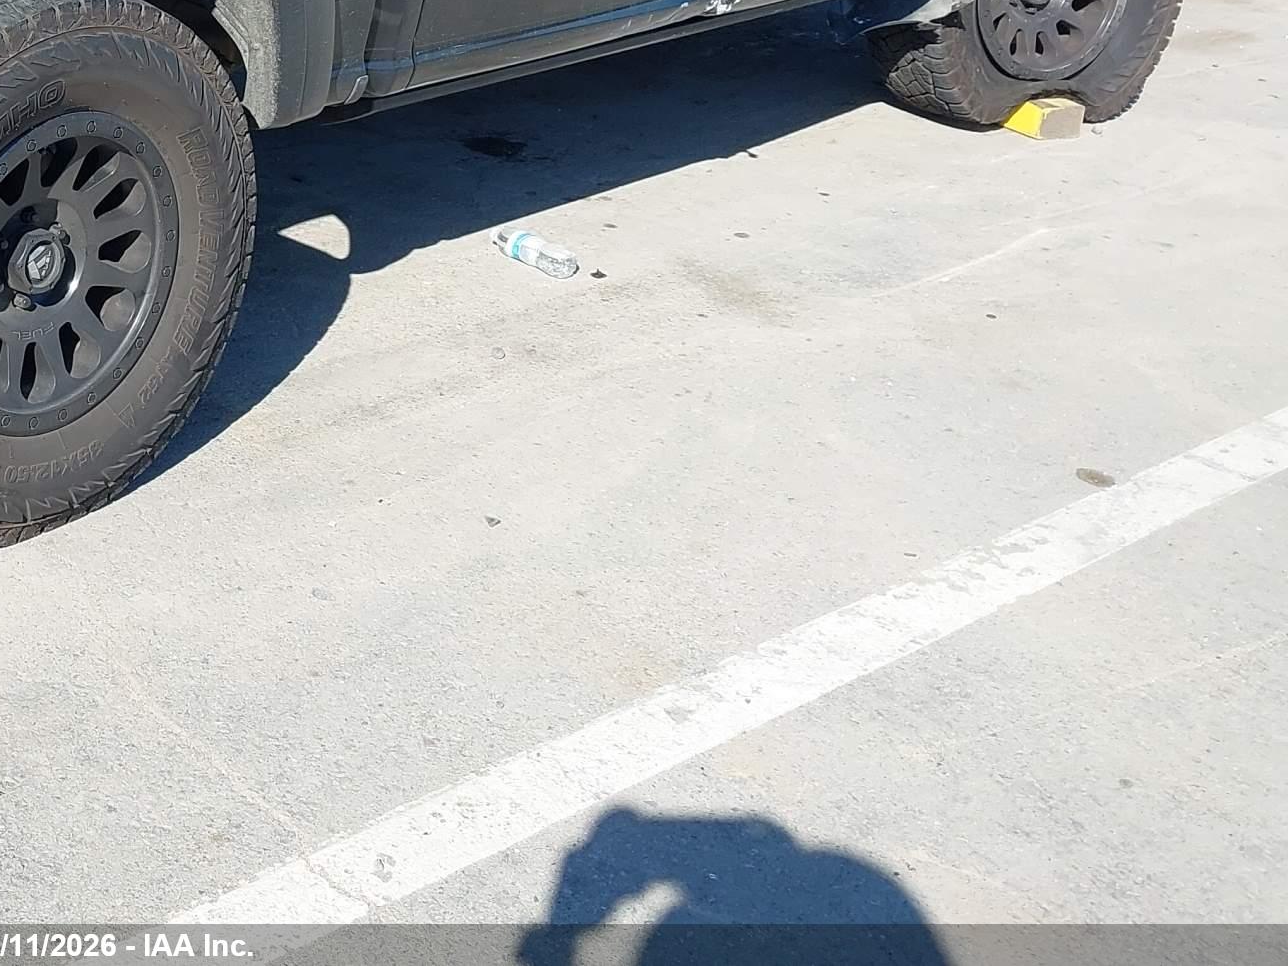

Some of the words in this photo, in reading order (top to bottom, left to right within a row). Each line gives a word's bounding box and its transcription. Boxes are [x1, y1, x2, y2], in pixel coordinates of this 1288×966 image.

[176, 127, 219, 205] ROAD
[172, 209, 225, 356] VENTURE
[10, 321, 54, 340] FUEL
